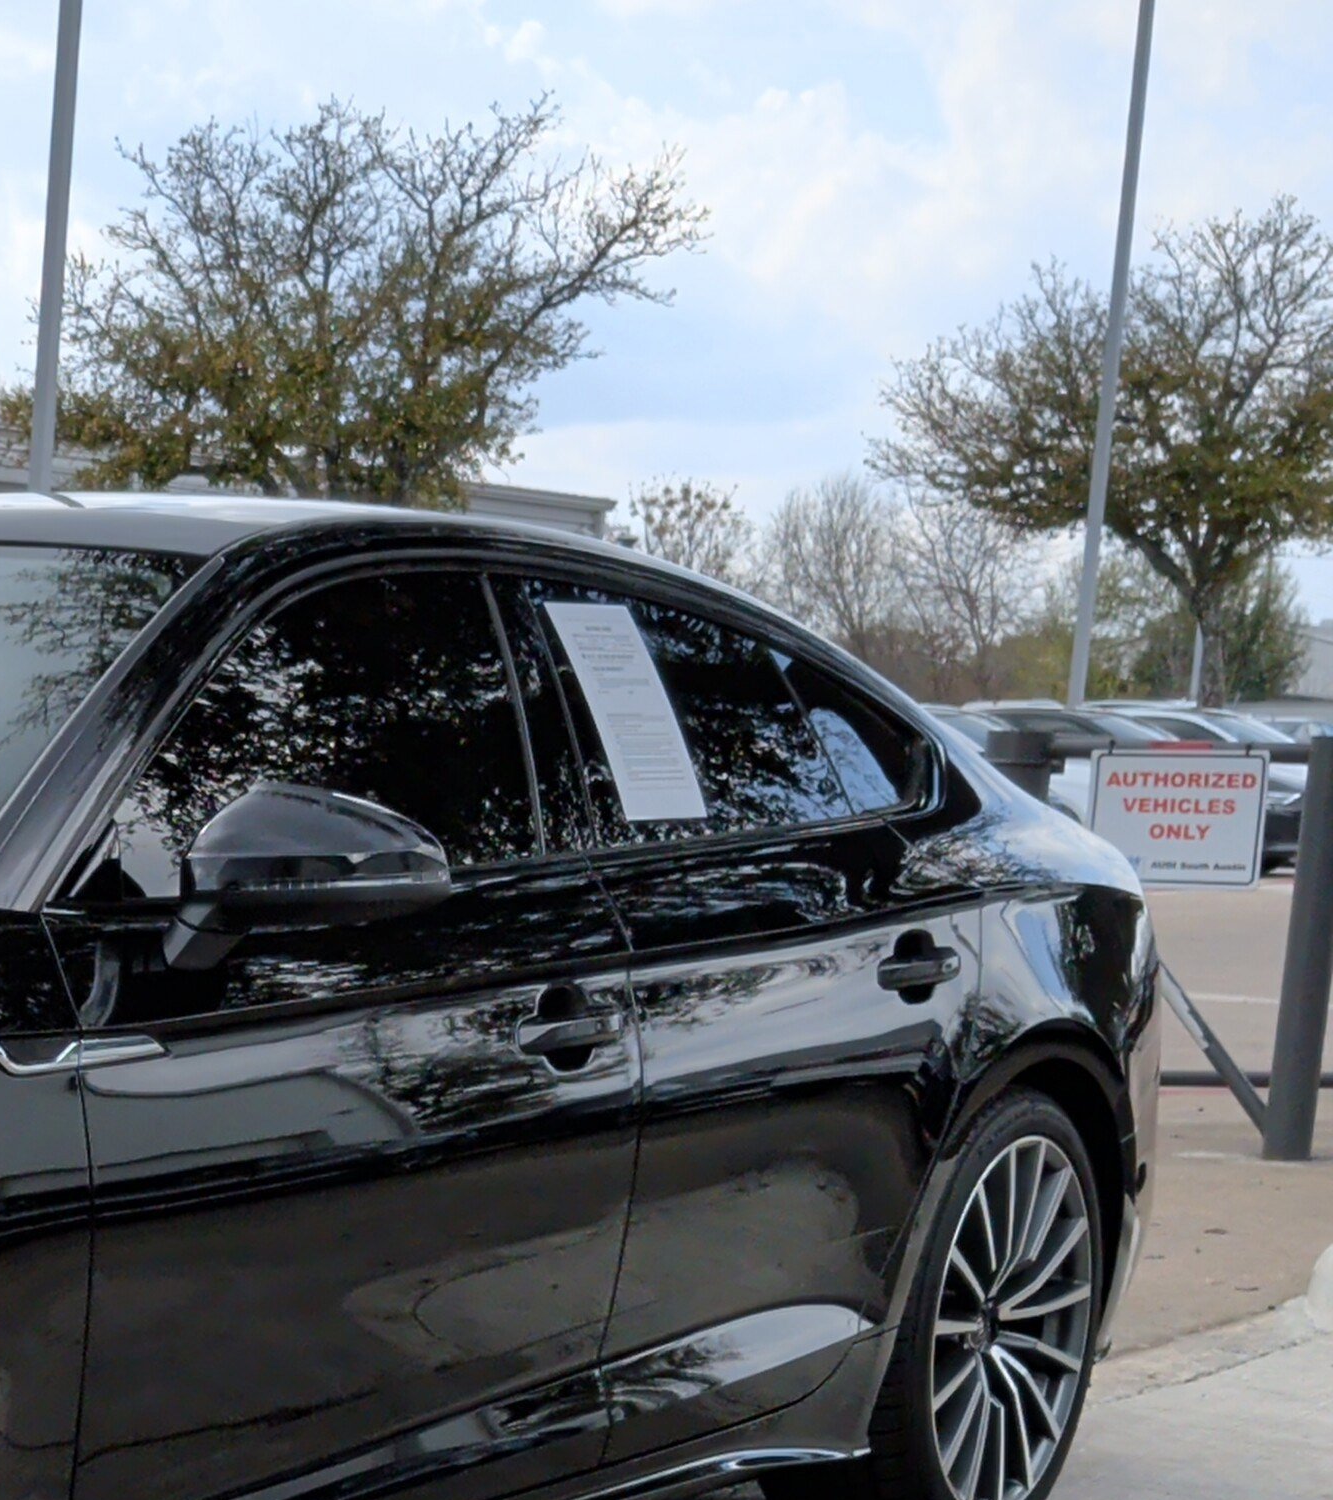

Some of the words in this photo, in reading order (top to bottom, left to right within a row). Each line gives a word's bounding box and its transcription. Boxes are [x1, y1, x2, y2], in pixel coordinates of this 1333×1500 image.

[1106, 771, 1258, 790] AUTHORIZED
[1123, 798, 1237, 816] VEHICLES
[1149, 824, 1211, 841] ONLY
